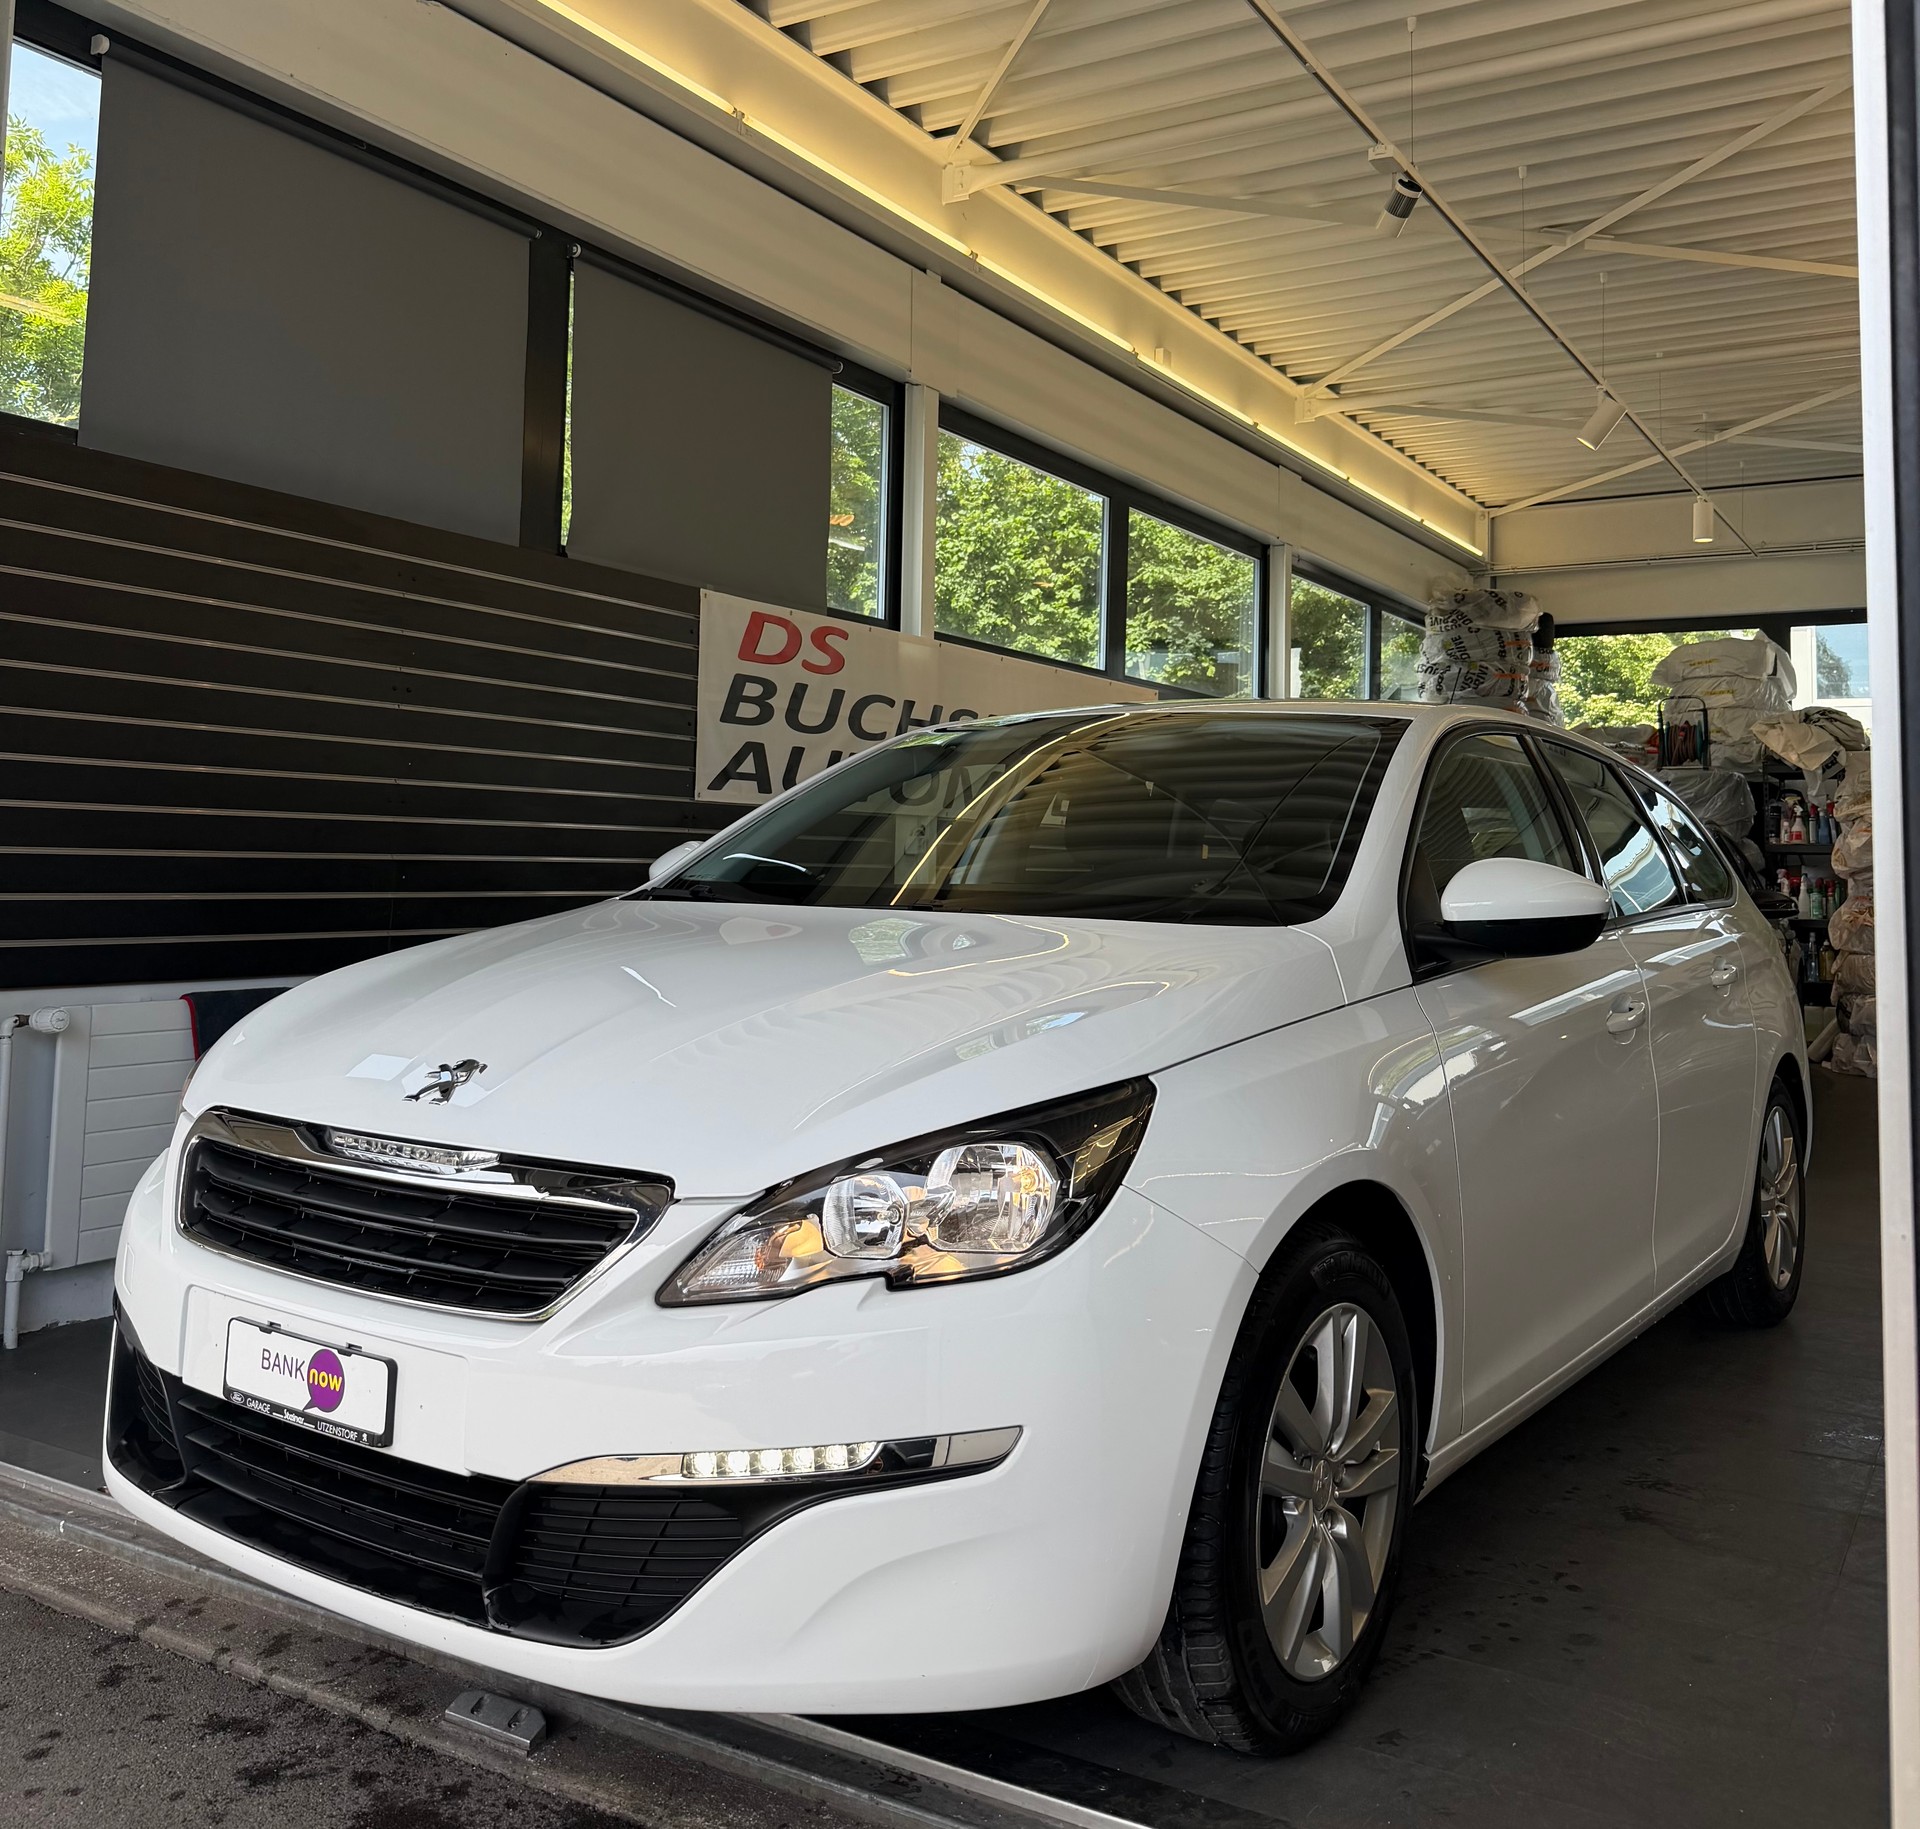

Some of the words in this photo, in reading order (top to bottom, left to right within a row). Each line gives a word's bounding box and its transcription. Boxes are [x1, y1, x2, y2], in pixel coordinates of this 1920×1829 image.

[737, 610, 849, 675] DS
[261, 1348, 305, 1382] BANK
[309, 1368, 342, 1392] now
[246, 1398, 271, 1414] GARAGE
[317, 1420, 358, 1441] UTZENSTORF
